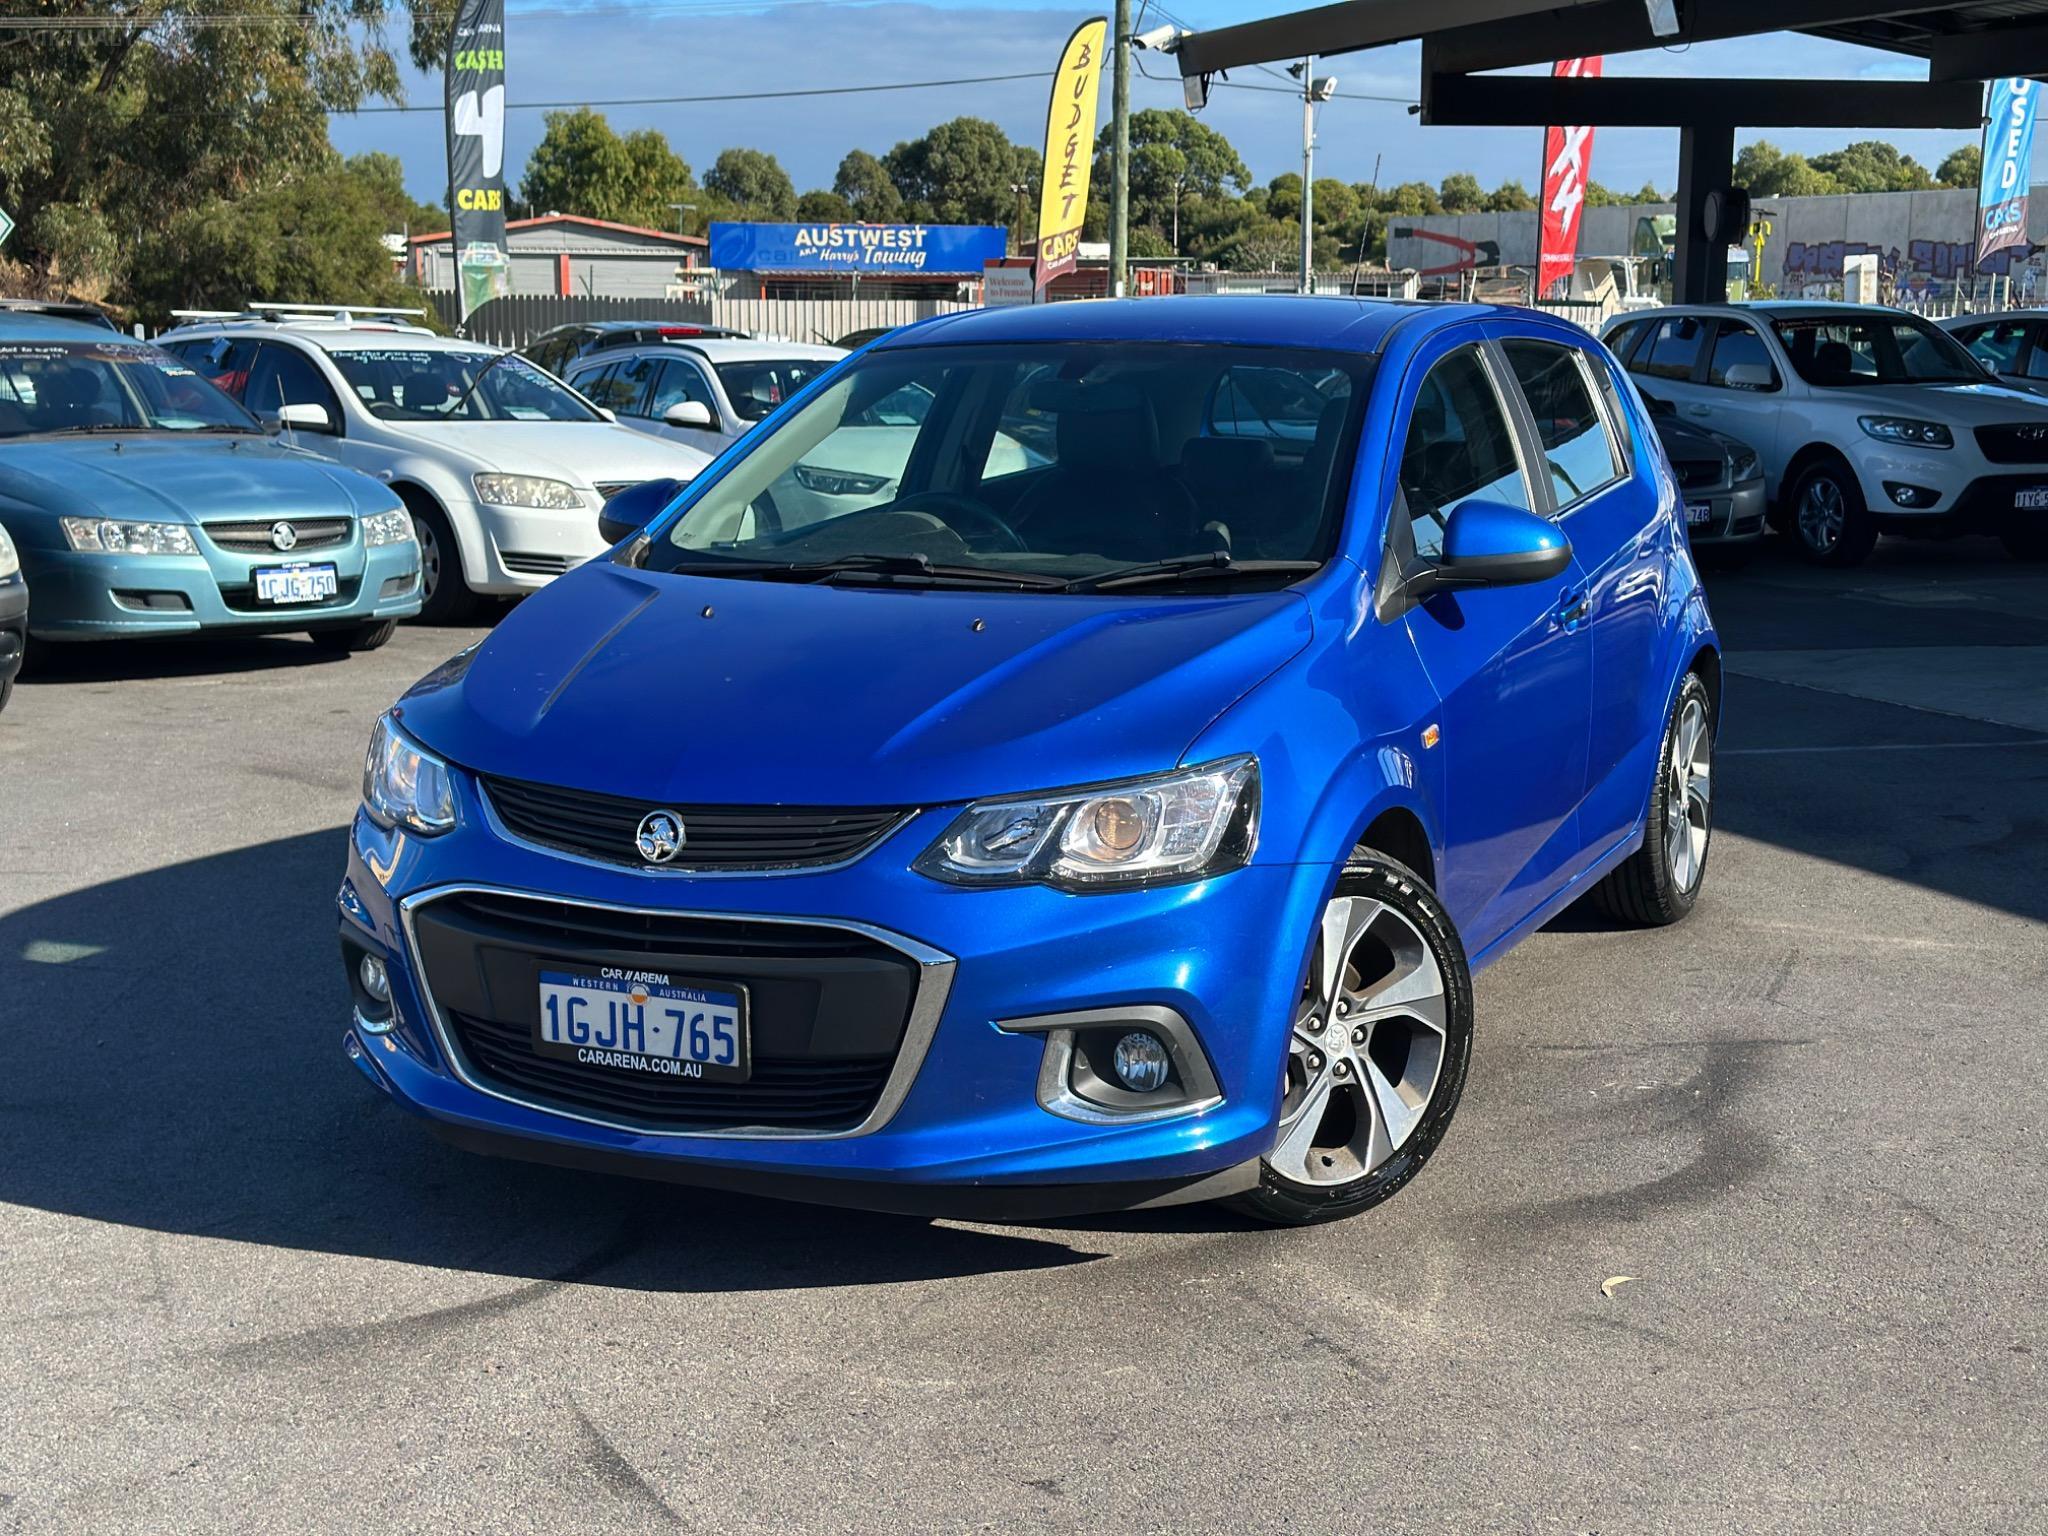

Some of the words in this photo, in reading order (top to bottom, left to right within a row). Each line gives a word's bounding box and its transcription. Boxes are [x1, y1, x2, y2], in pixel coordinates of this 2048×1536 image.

[454, 84, 504, 178] 4
[1059, 43, 1091, 220] BUDGET
[2001, 77, 2031, 189] USED
[794, 228, 927, 248] AUSTWEST
[1042, 230, 1079, 262] CARS
[864, 245, 927, 269] Towing
[601, 967, 623, 980] CAR
[572, 977, 619, 991] WESTERN
[659, 988, 707, 1002] AUSTRALIA
[578, 1048, 702, 1079] CARARENA.COM.AU
